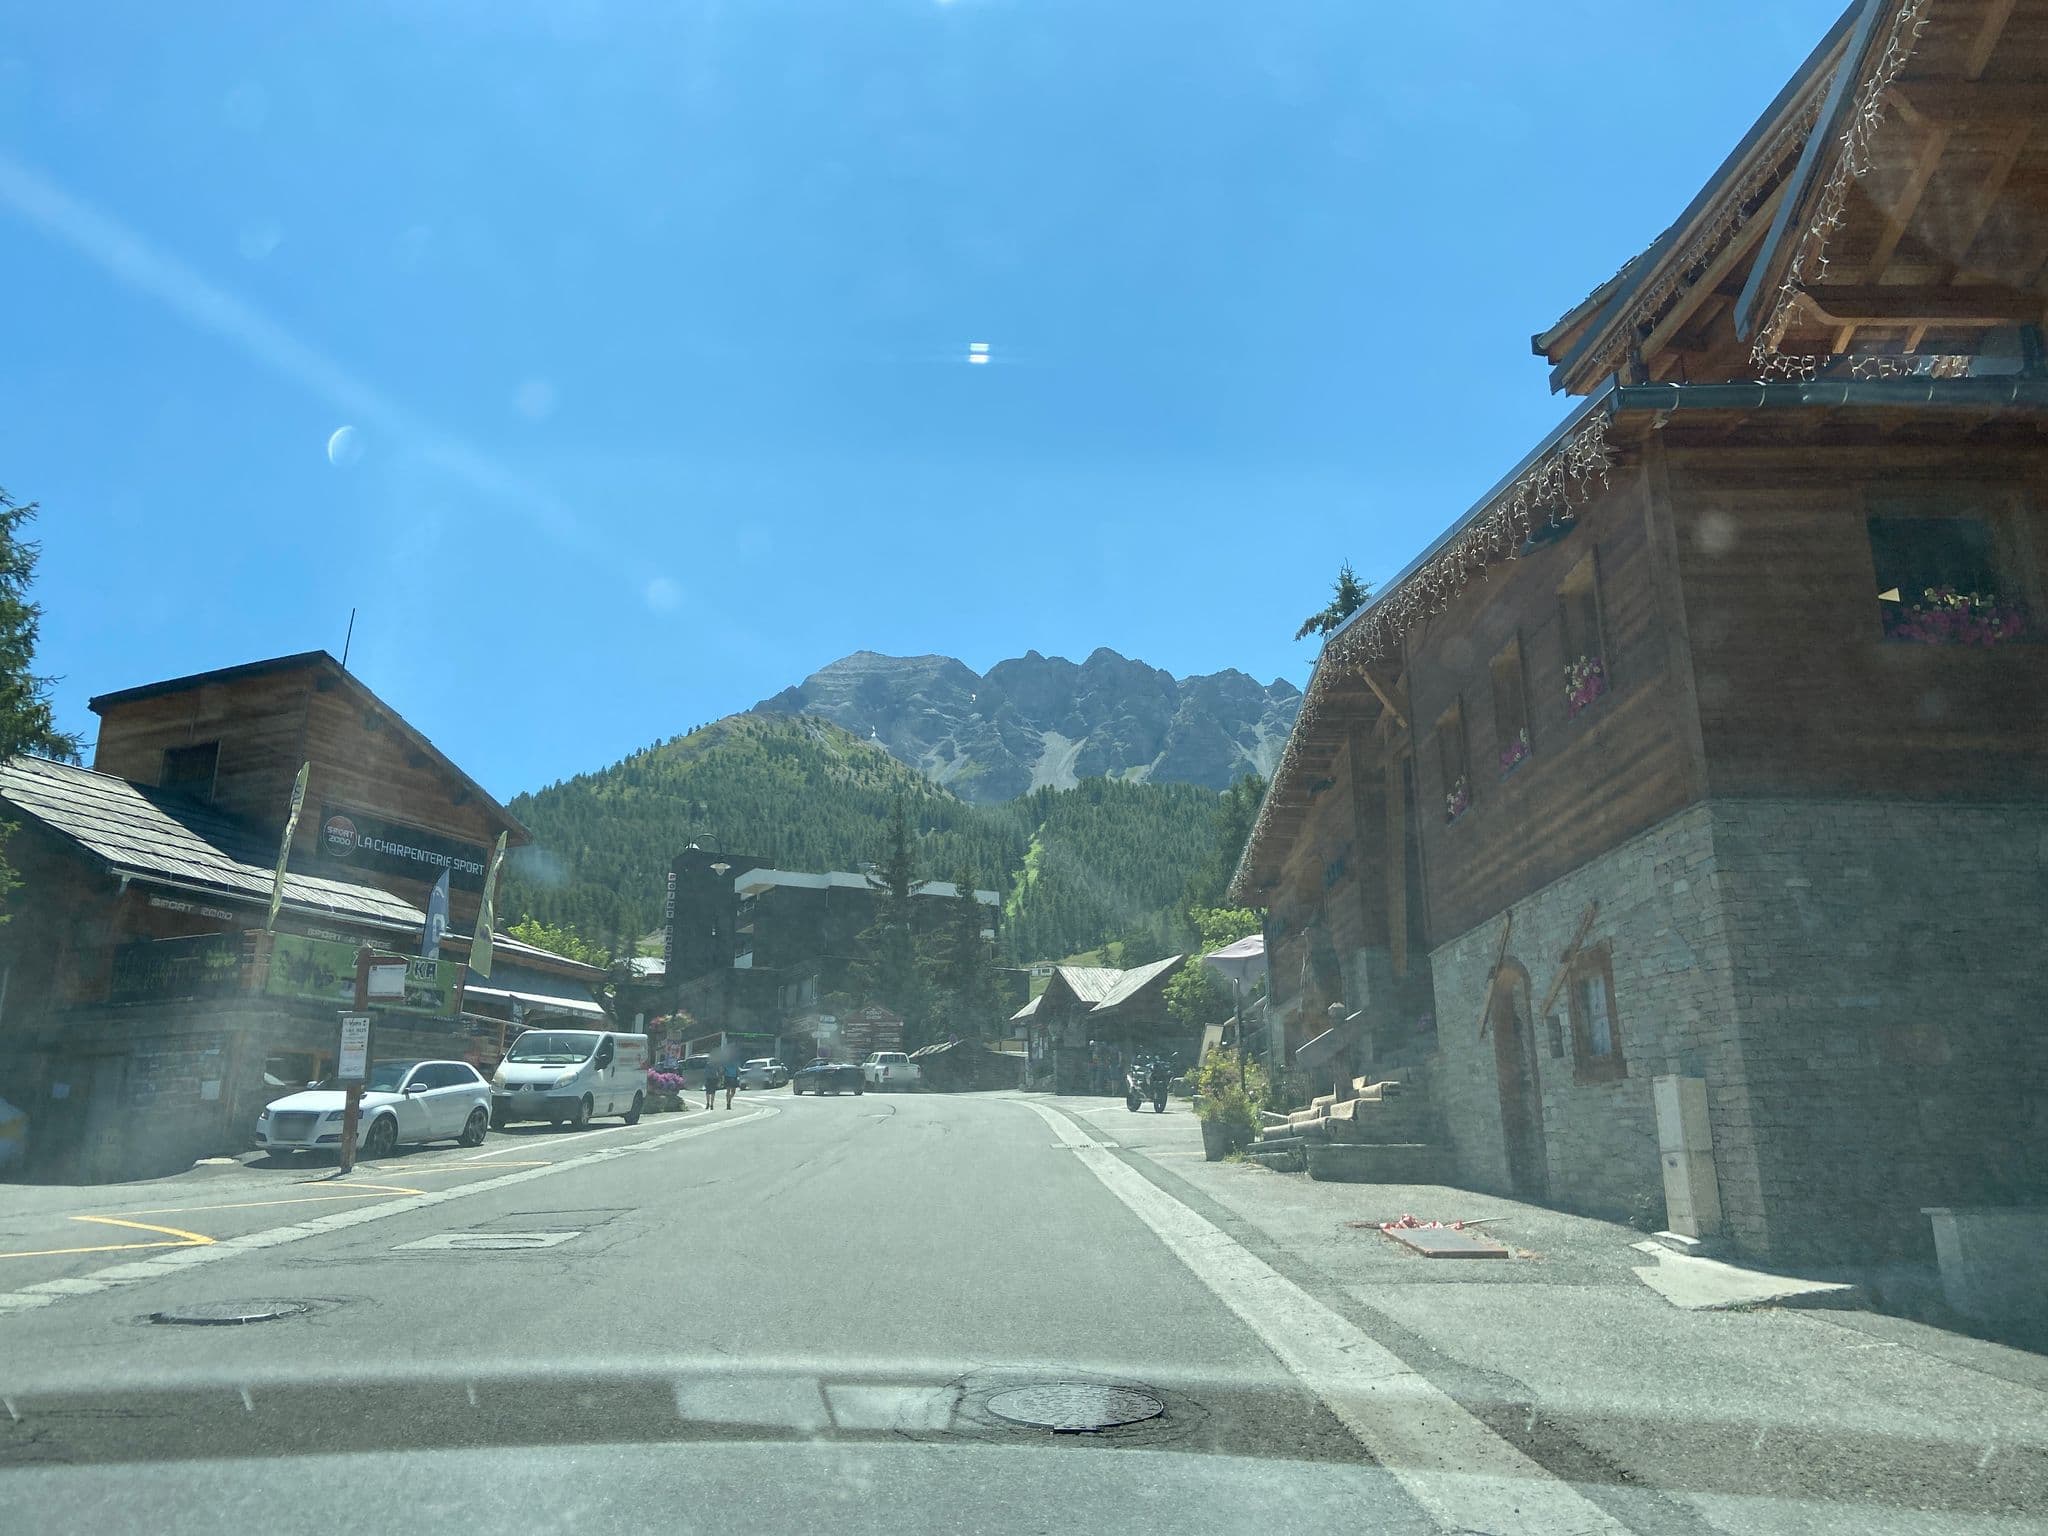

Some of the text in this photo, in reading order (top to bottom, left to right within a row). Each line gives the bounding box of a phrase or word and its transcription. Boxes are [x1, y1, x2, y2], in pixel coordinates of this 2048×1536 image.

[326, 825, 354, 839] SPORT
[328, 834, 351, 846] 2000
[357, 834, 485, 876] LA CHARPENTERIE SPORT
[151, 897, 233, 920] SPORT 2000
[307, 927, 342, 942] SPORT
